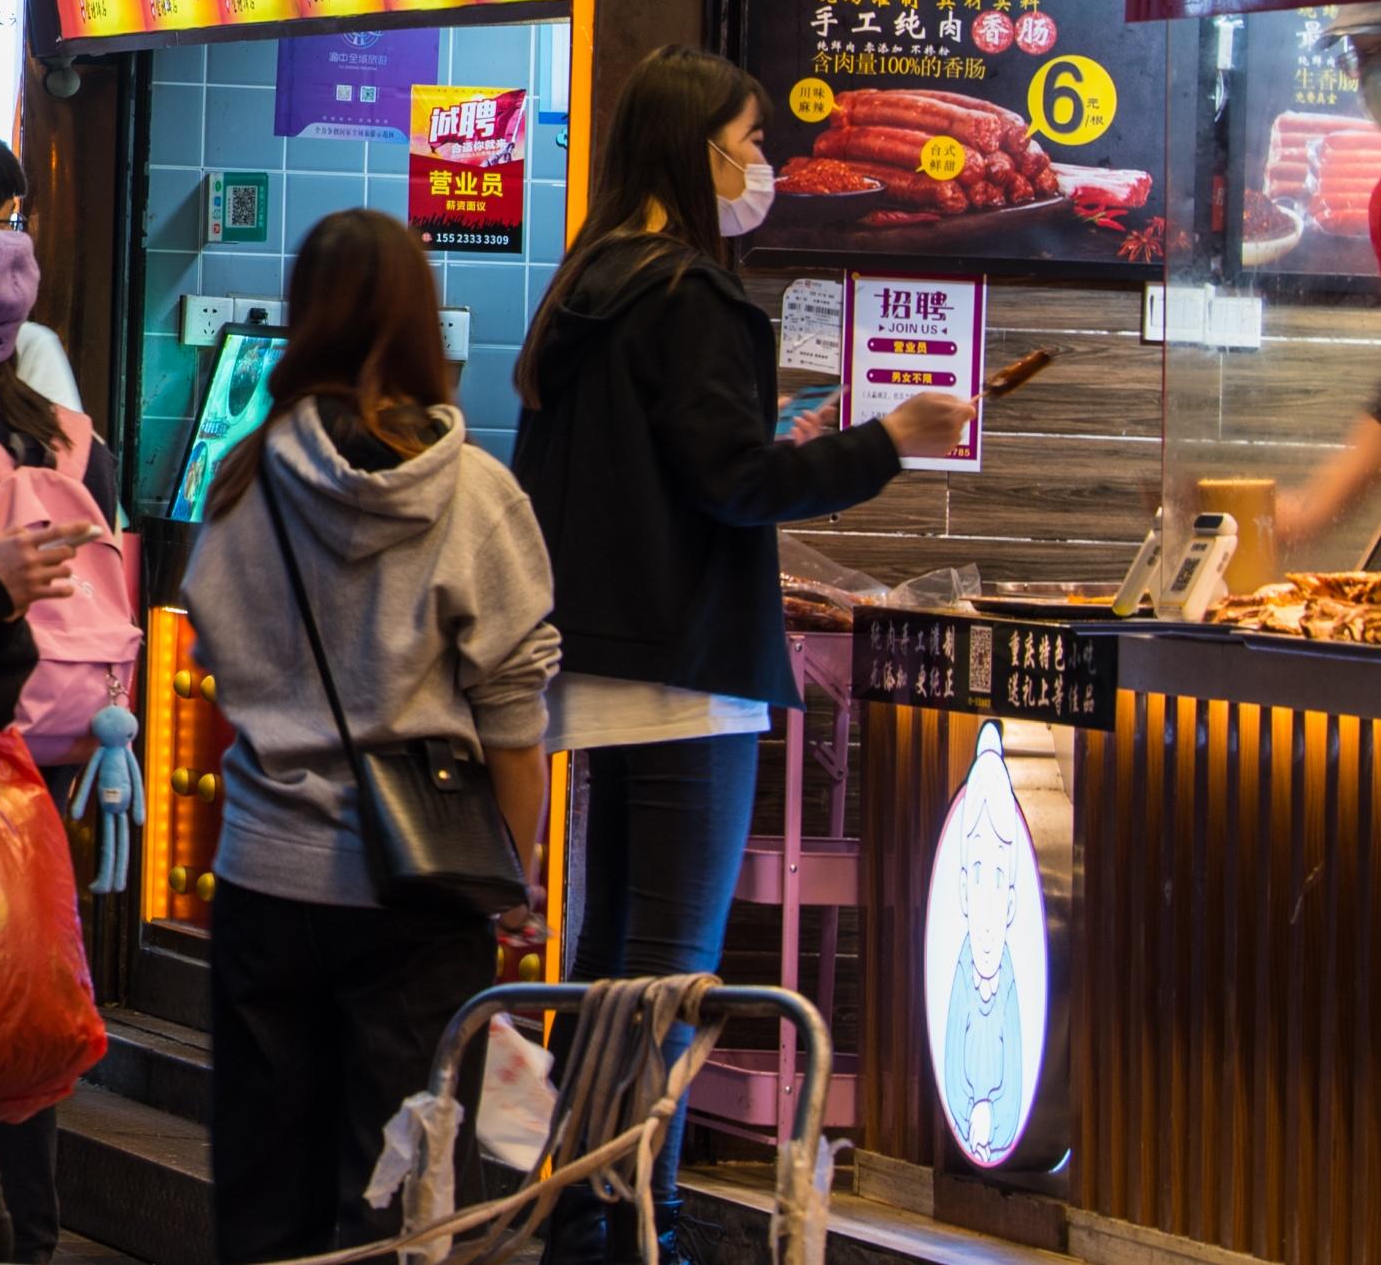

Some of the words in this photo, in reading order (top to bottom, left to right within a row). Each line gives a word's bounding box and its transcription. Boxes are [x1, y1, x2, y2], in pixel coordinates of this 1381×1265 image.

[810, 5, 1053, 50] 手工纯肉香肠
[817, 41, 856, 53] 纯鲜肉
[812, 51, 986, 80] 含肉量100%的香肠
[799, 87, 825, 98] 川味
[1043, 61, 1084, 133] 6
[798, 102, 825, 114] 麻辣
[428, 100, 497, 143] 诚聘
[930, 144, 956, 157] 台式
[929, 160, 956, 173] 鲜甜
[430, 170, 503, 197] 营业员
[446, 200, 486, 212] 薪资面议
[436, 233, 455, 243] 155
[457, 233, 482, 244] 2333
[484, 234, 509, 245] 3309
[874, 288, 954, 321] 招聘
[889, 323, 918, 334] JOIN
[921, 325, 938, 335] US
[893, 341, 928, 354] 营业员
[892, 371, 933, 384] 男女不限
[1008, 629, 1097, 675] 重庆特色小吃
[1007, 672, 1095, 716] 送礼上等佳品
